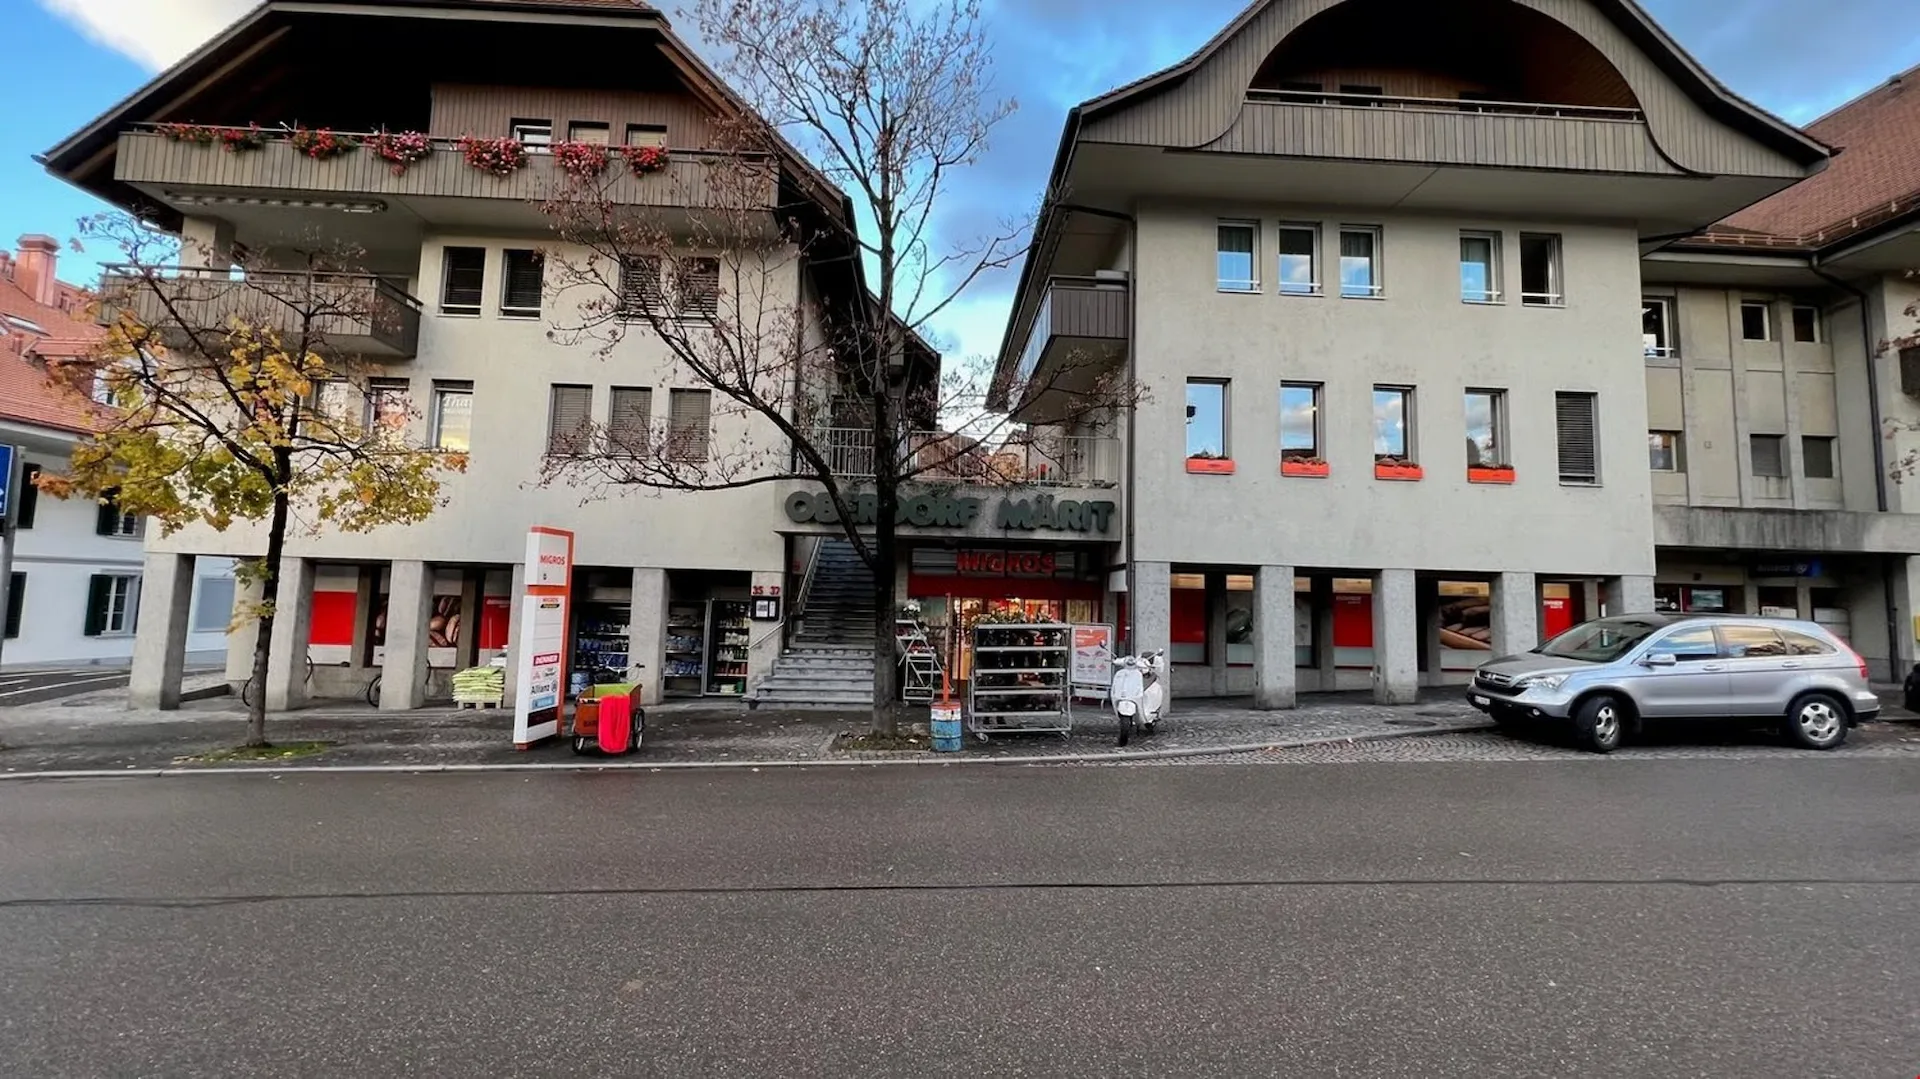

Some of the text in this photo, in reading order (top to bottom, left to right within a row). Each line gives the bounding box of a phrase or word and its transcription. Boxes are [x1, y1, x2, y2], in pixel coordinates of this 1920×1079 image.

[997, 493, 1115, 532] MÄRIT
[540, 554, 566, 566] MIGROS
[957, 551, 1056, 573] MIGROS
[752, 585, 780, 596] 35 37
